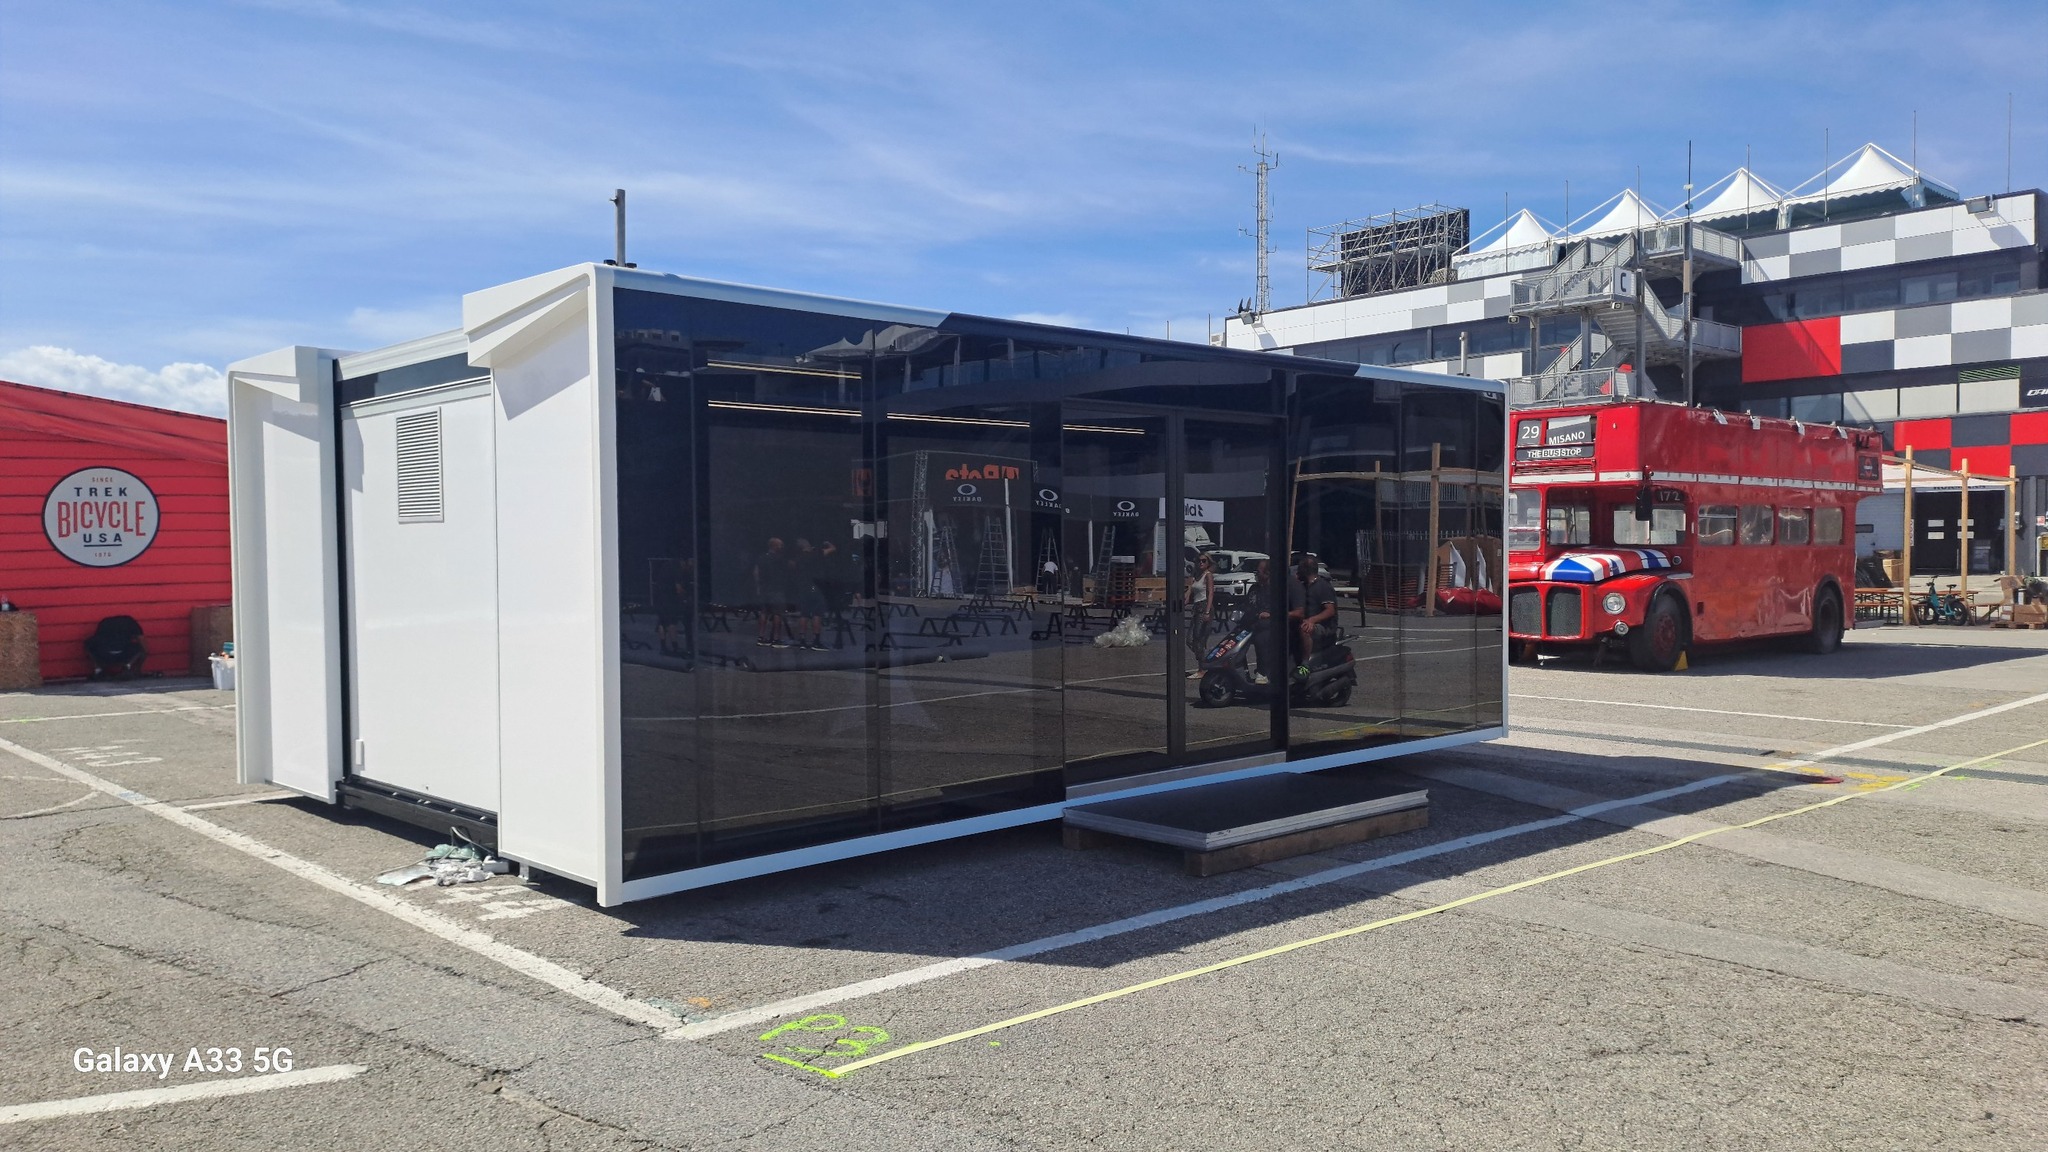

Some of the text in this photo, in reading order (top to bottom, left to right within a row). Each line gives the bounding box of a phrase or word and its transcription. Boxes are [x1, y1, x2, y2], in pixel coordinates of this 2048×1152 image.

[1620, 272, 1627, 293] C
[1521, 425, 1540, 439] 29
[1548, 431, 1586, 445] MISANO
[1543, 449, 1560, 457] BUS
[1561, 448, 1582, 456] STOP
[74, 487, 127, 496] TREK
[1660, 491, 1680, 501] 172
[57, 501, 146, 538] BICYCLE
[83, 533, 122, 542] USA
